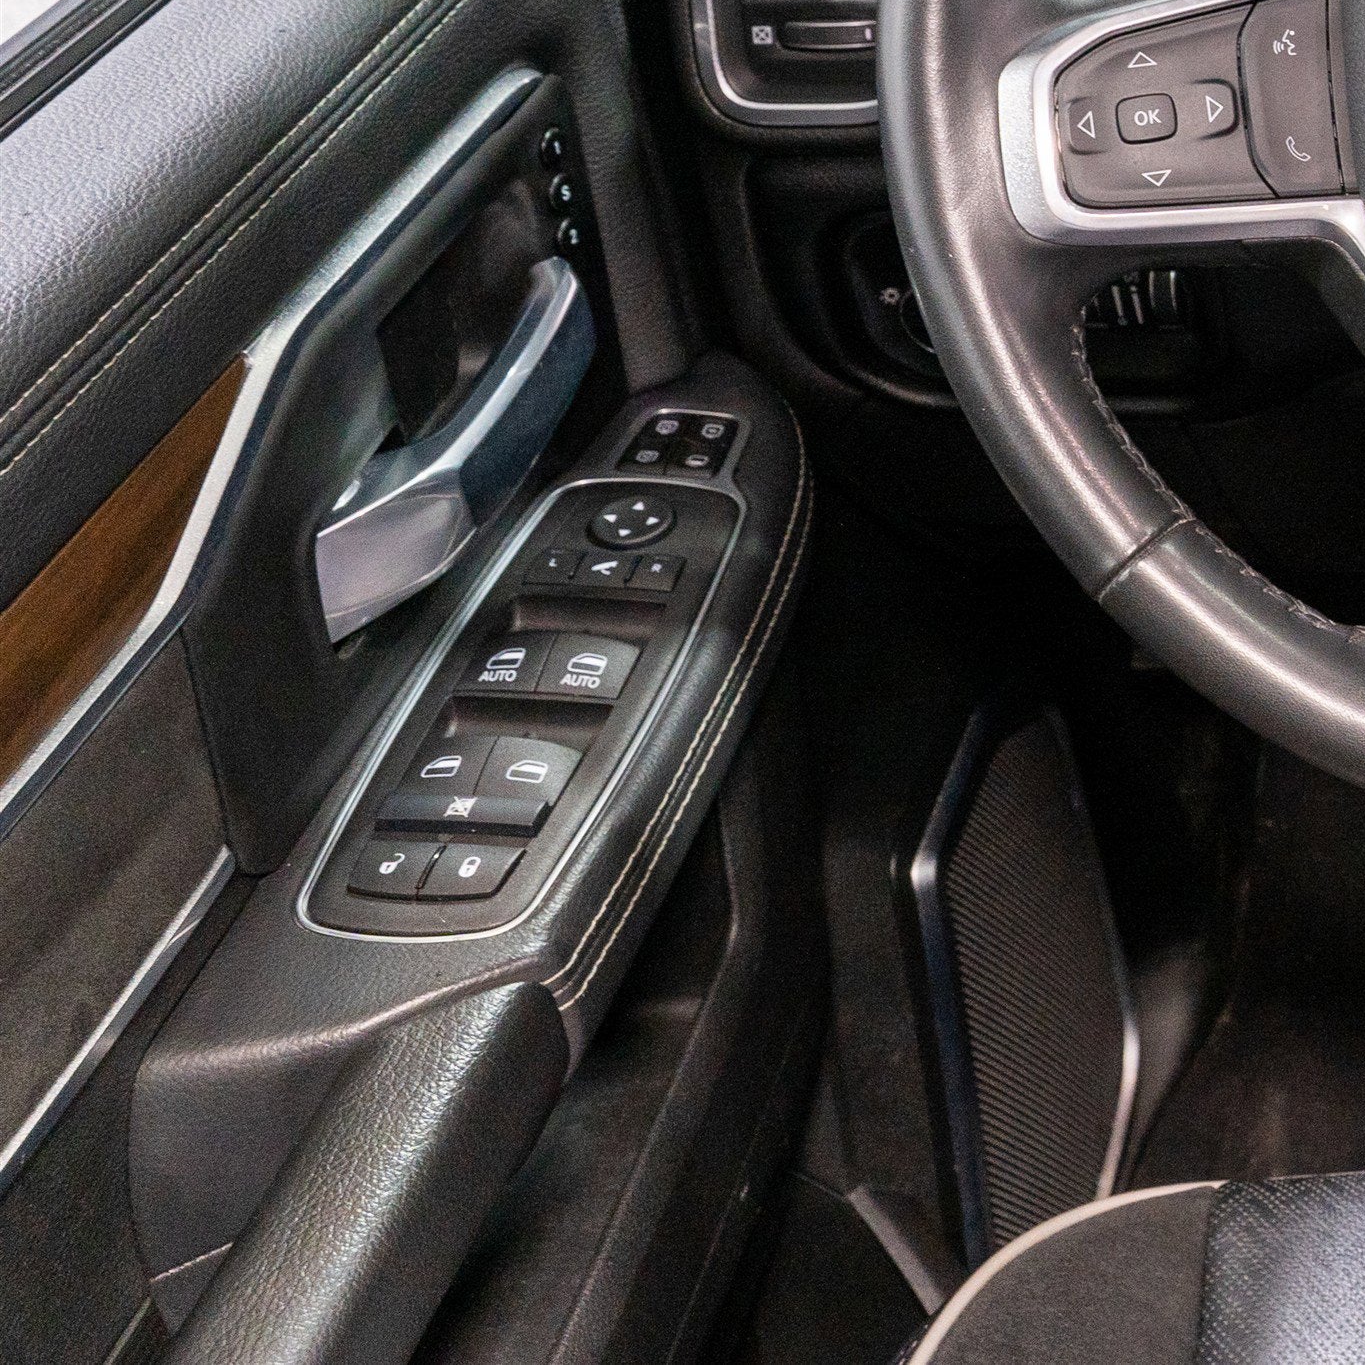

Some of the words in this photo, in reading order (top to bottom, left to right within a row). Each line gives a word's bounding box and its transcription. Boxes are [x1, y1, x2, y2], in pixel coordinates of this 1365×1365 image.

[1134, 110, 1162, 126] OK
[560, 184, 572, 202] S
[568, 228, 579, 245] 2
[478, 668, 517, 684] AUTO
[559, 673, 601, 689] AUTO
